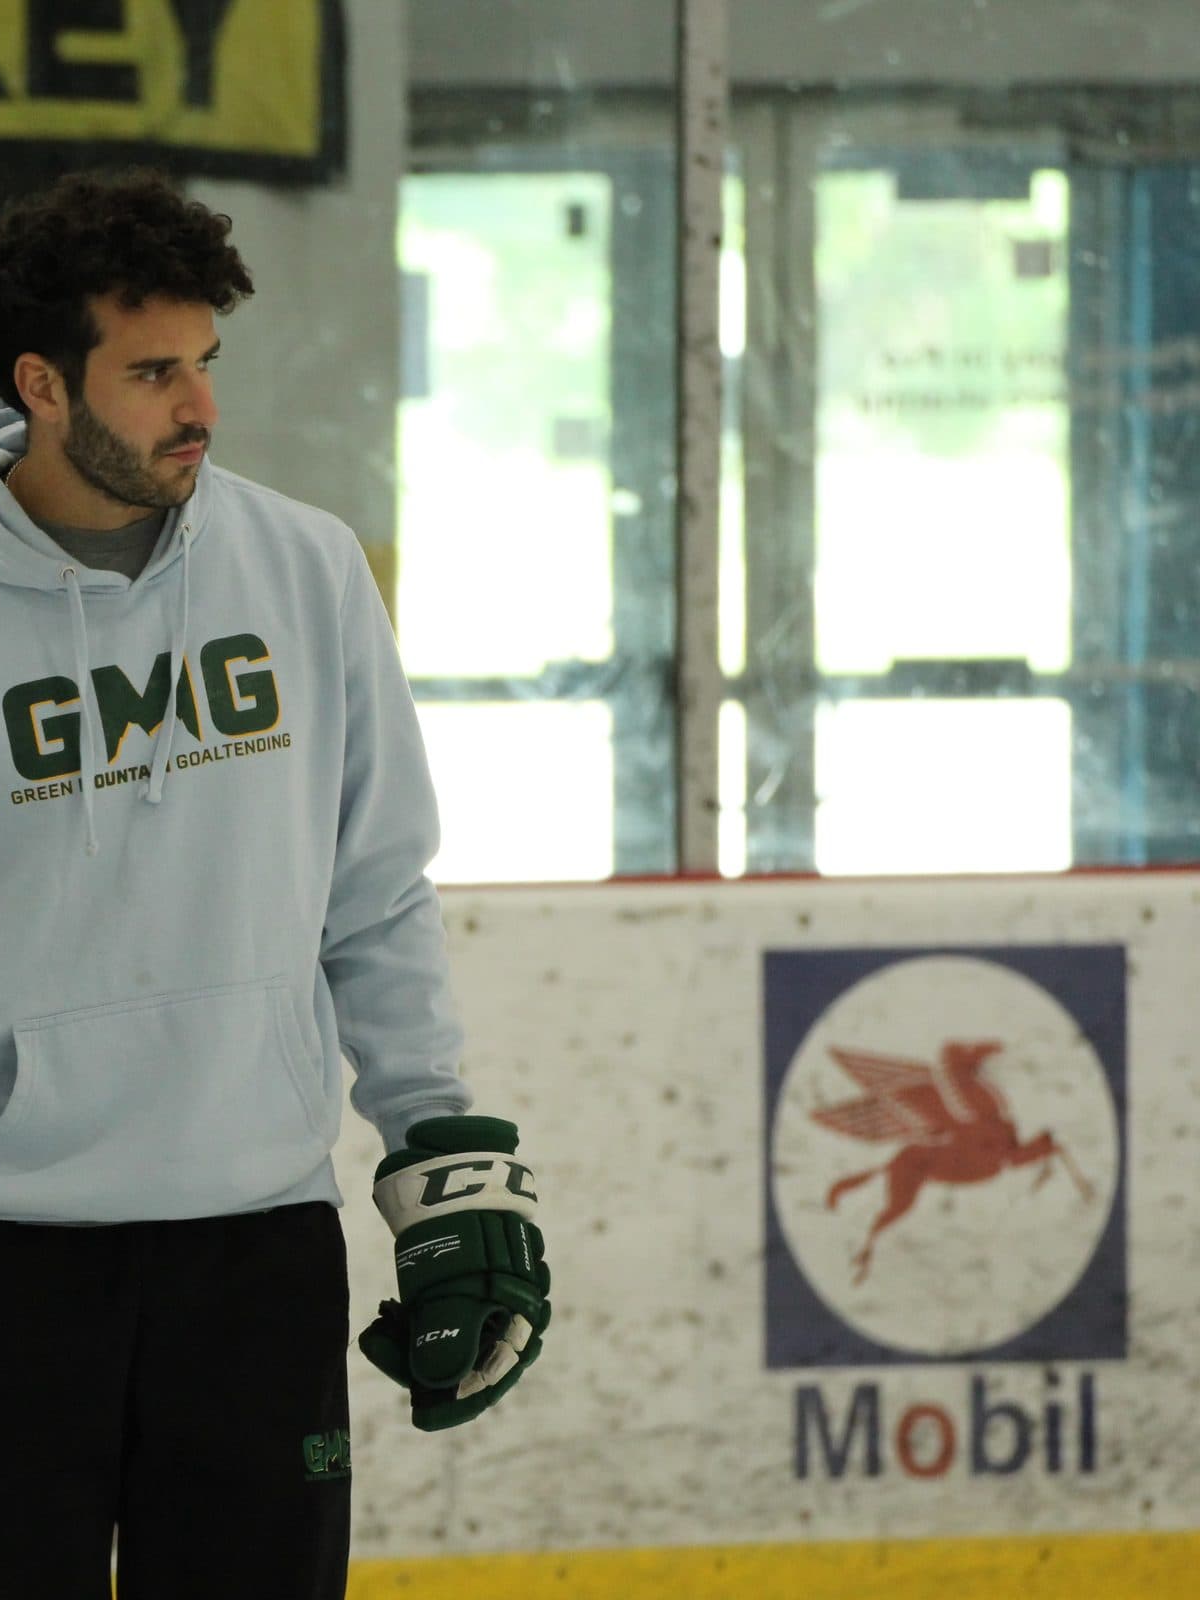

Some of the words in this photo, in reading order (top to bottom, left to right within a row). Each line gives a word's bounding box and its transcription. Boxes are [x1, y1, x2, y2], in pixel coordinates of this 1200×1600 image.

[2, 633, 281, 782] GMG
[11, 780, 73, 805] GREEN
[78, 760, 171, 793] OUNTA
[176, 733, 291, 770] GOALTENDING
[419, 1160, 538, 1206] CC
[416, 1328, 460, 1347] CCM
[303, 1429, 351, 1473] GM
[794, 1369, 1097, 1480] Mobil
